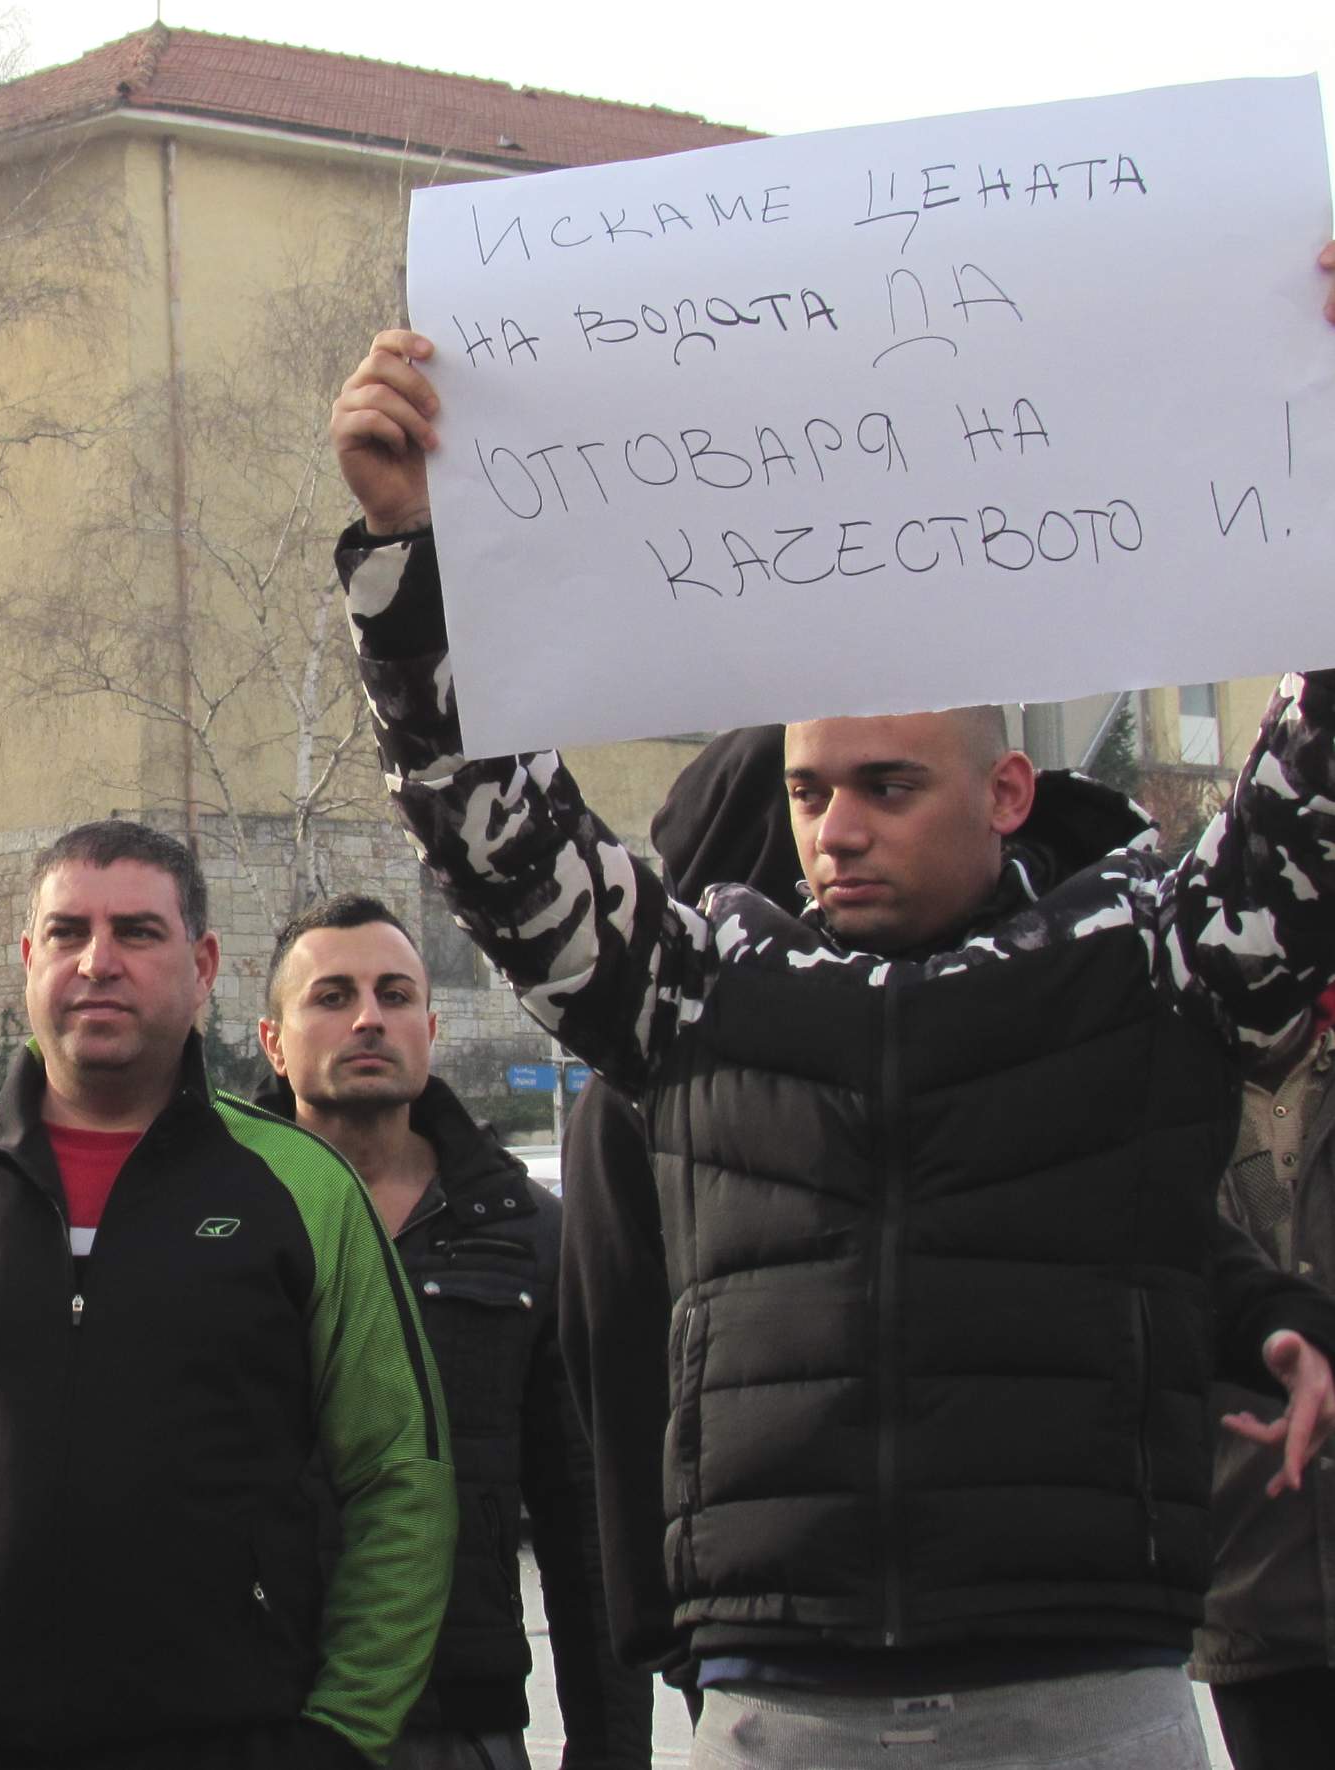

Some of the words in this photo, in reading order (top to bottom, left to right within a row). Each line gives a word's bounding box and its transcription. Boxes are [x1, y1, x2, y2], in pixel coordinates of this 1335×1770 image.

[472, 186, 790, 265] ИСКАМЕ
[854, 153, 1147, 255] ЦЕНАТА
[452, 315, 540, 368] НА
[873, 264, 1023, 368] ДА
[475, 413, 908, 519] ОТГОВАРЯ
[956, 398, 1049, 462] НА
[645, 499, 1142, 600] КАЧЕСТВОТО
